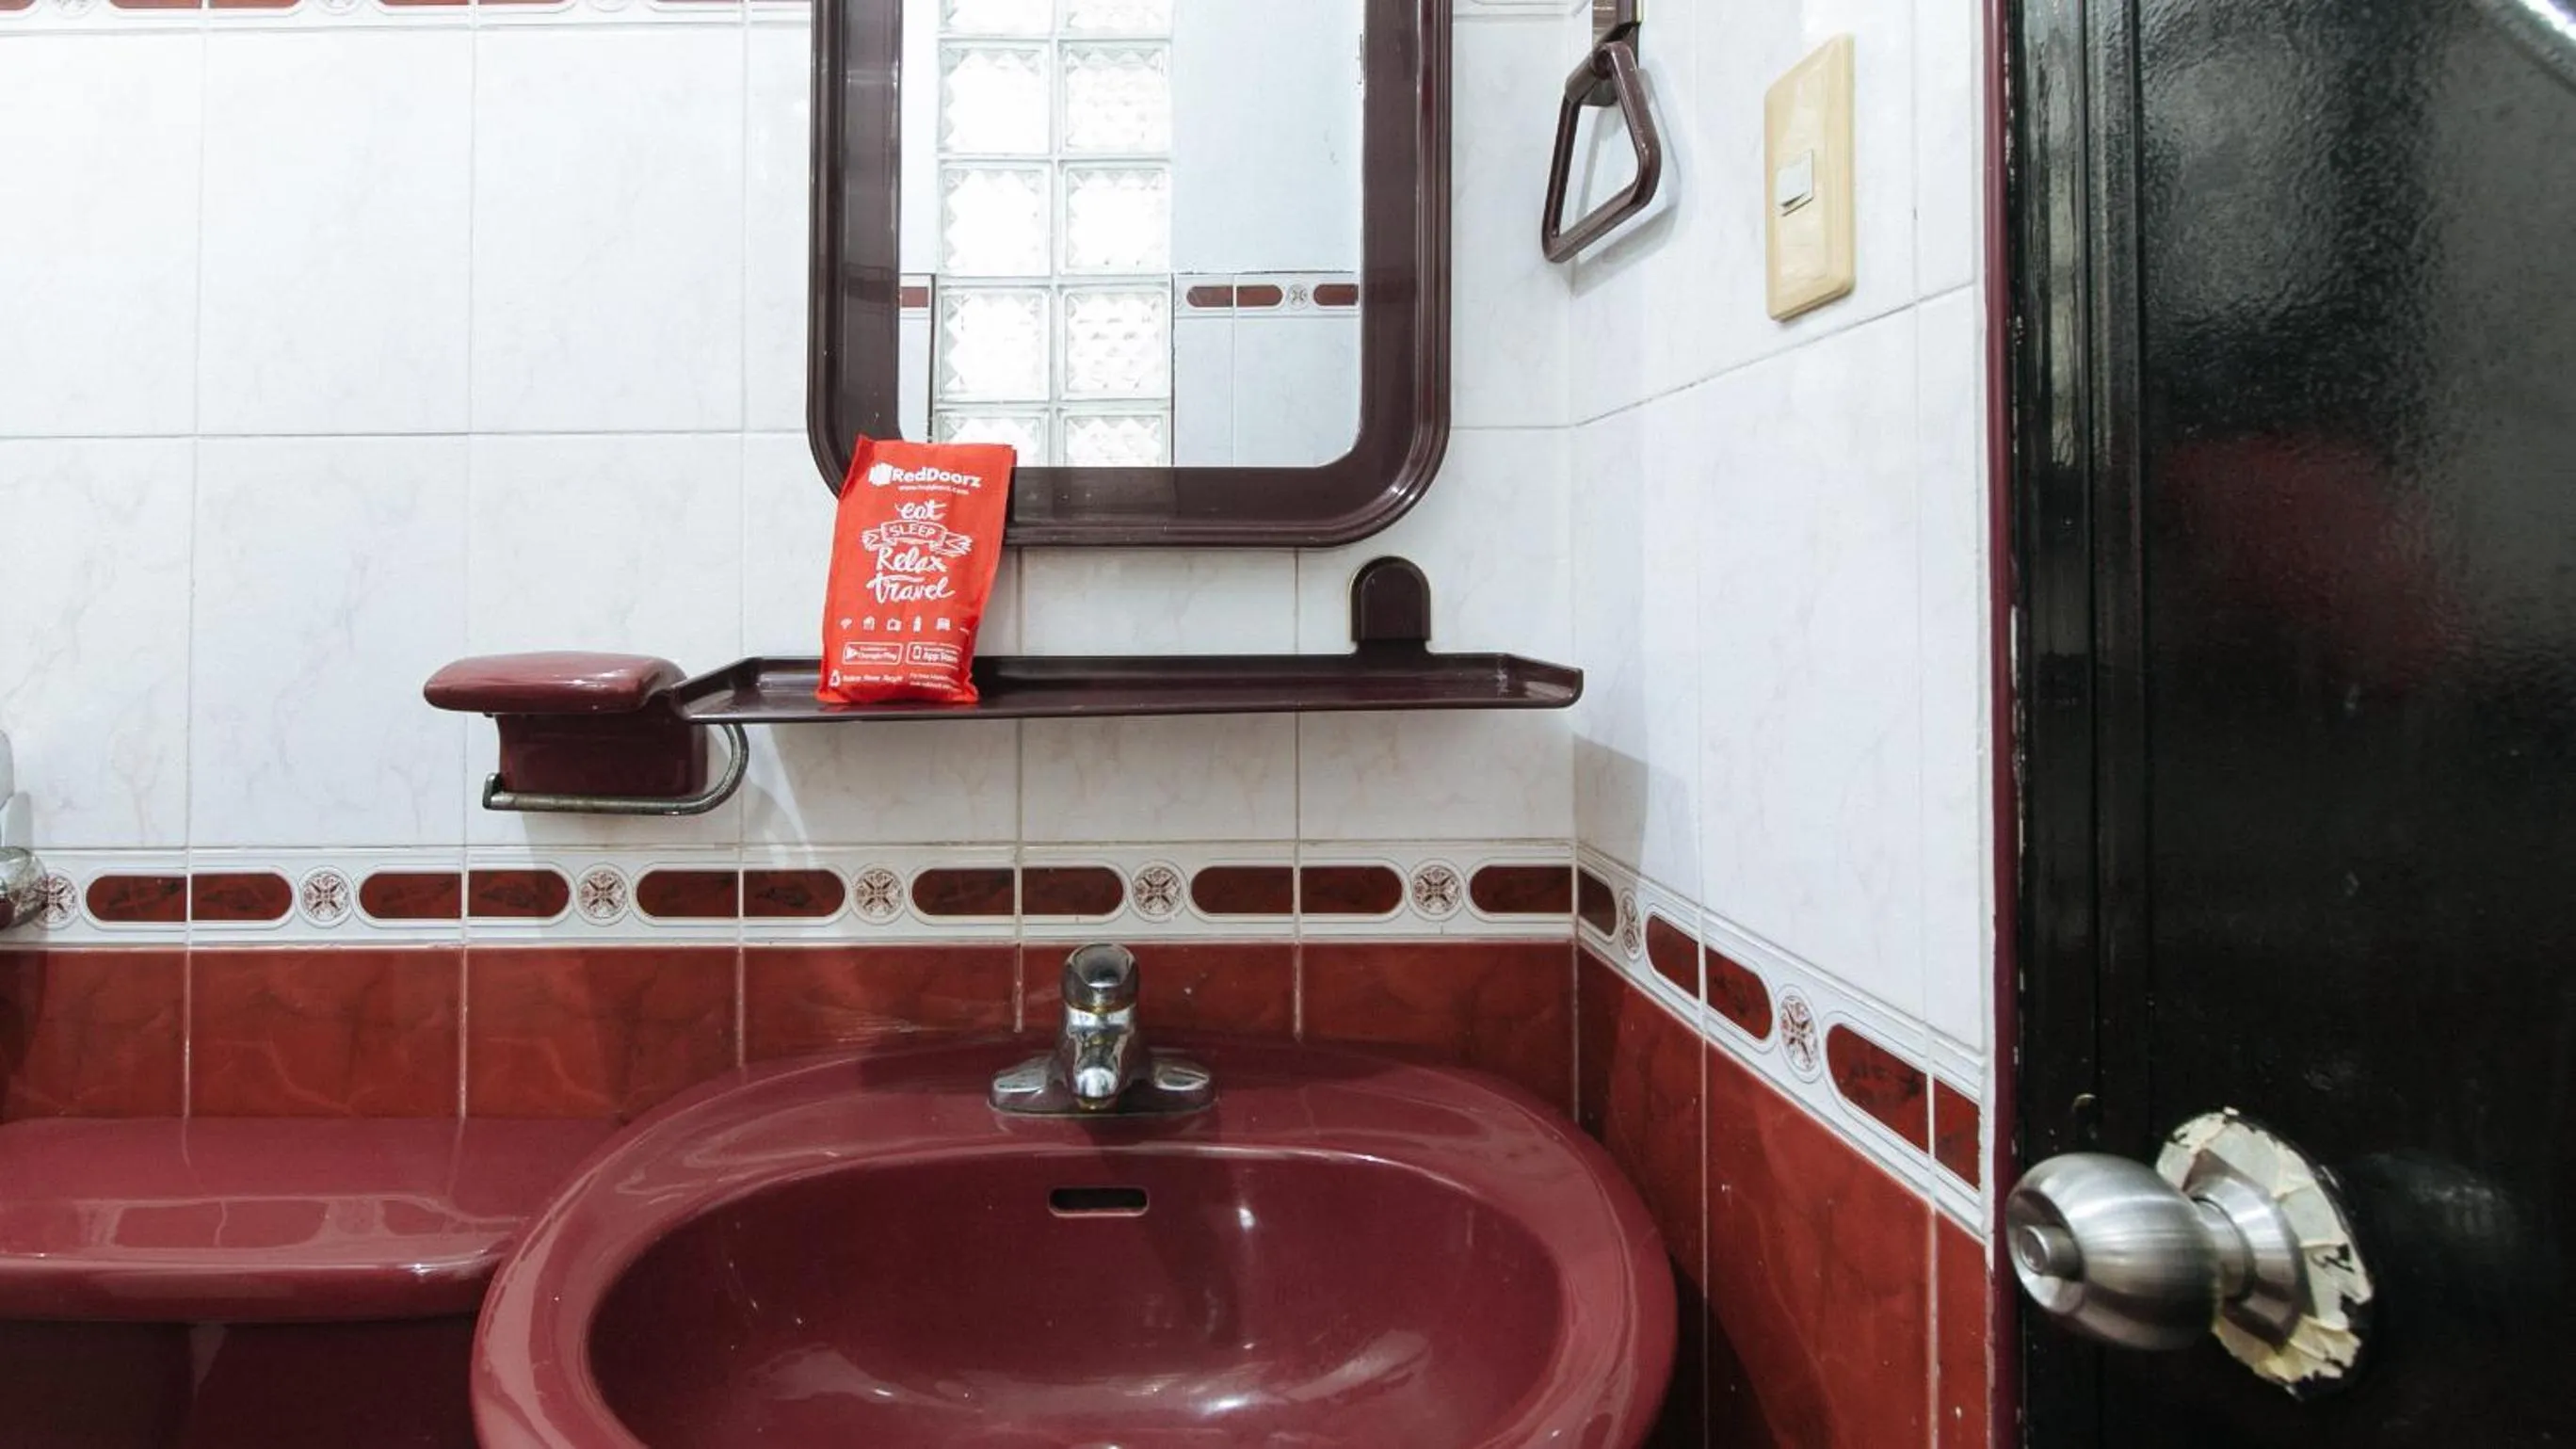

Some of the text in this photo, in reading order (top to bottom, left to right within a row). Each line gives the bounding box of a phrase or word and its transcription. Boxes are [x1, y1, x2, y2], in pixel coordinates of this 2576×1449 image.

[892, 466, 981, 488] RedDoorz
[894, 499, 947, 520] eat
[889, 523, 936, 538] SLEEP
[876, 546, 947, 572] Relax
[866, 572, 956, 604] travel
